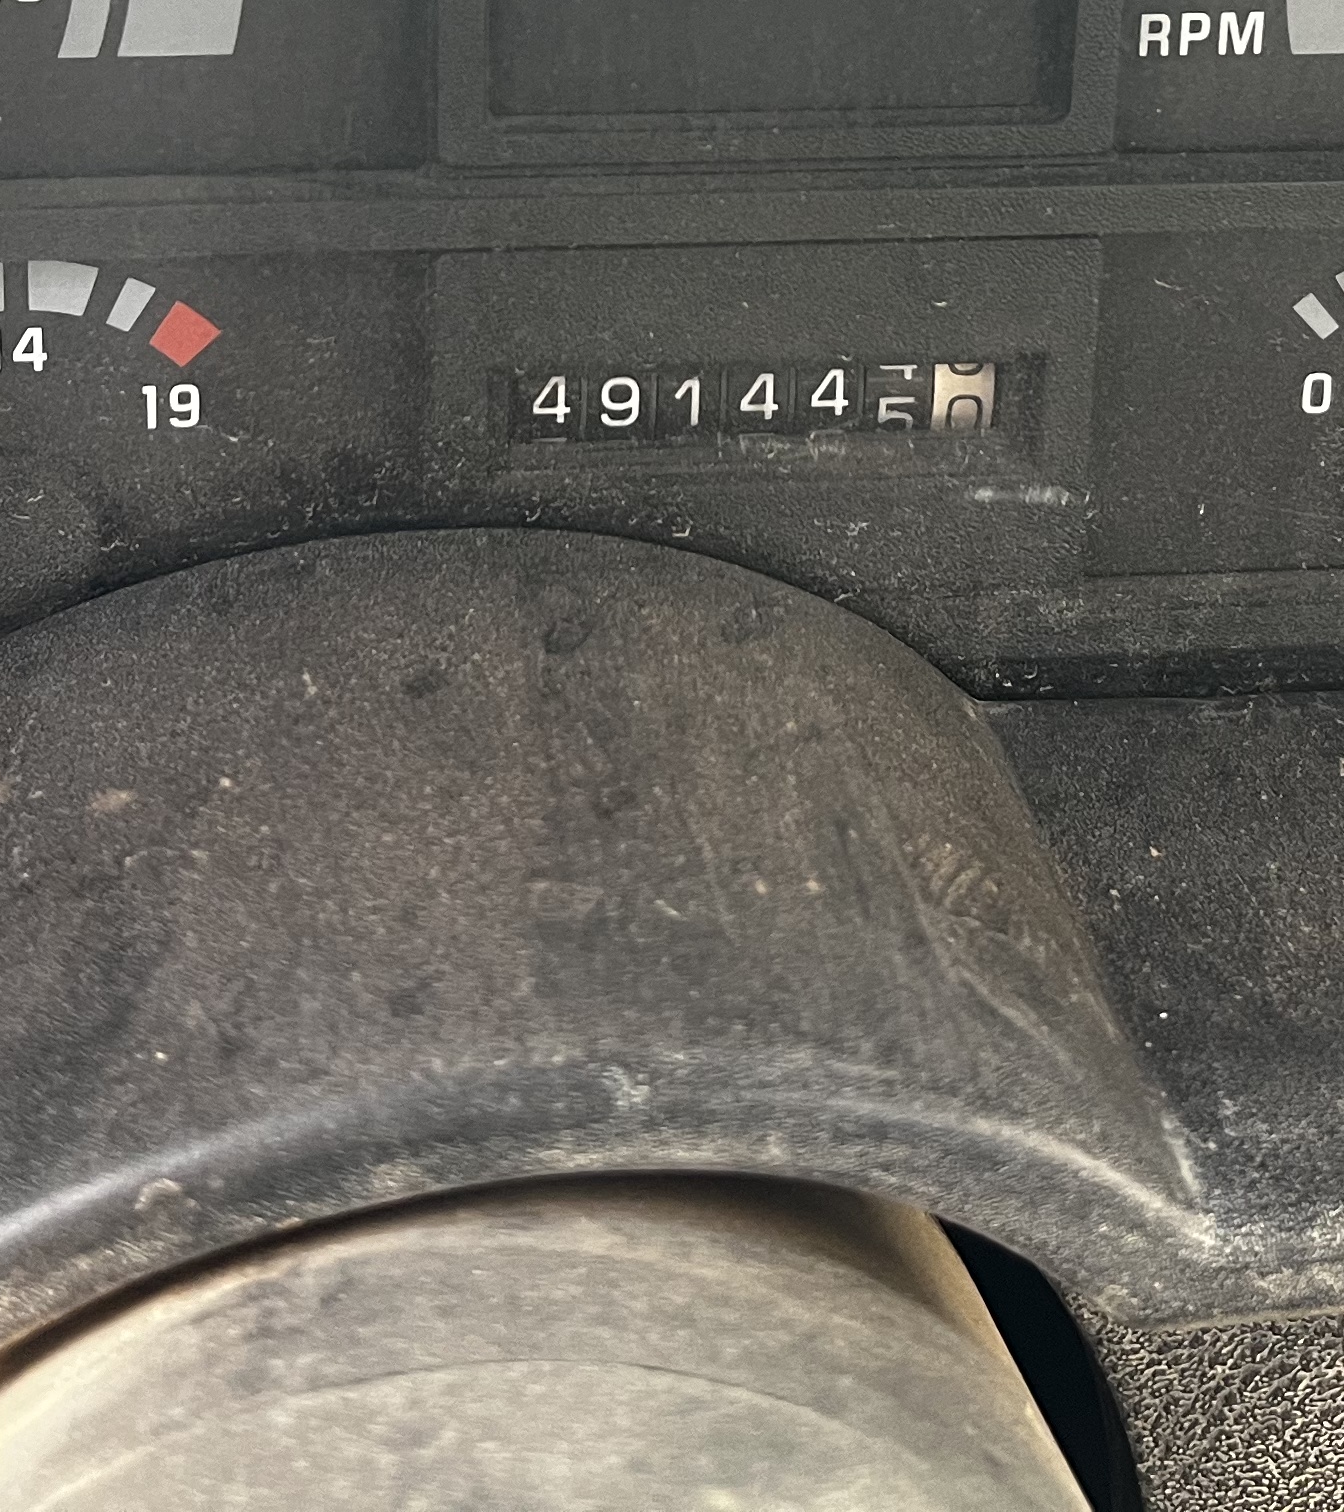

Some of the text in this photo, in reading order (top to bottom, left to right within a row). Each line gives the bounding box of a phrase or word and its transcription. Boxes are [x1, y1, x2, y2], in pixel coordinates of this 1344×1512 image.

[1138, 11, 1265, 57] RPM
[141, 384, 202, 429] 19
[1301, 372, 1333, 414] 0
